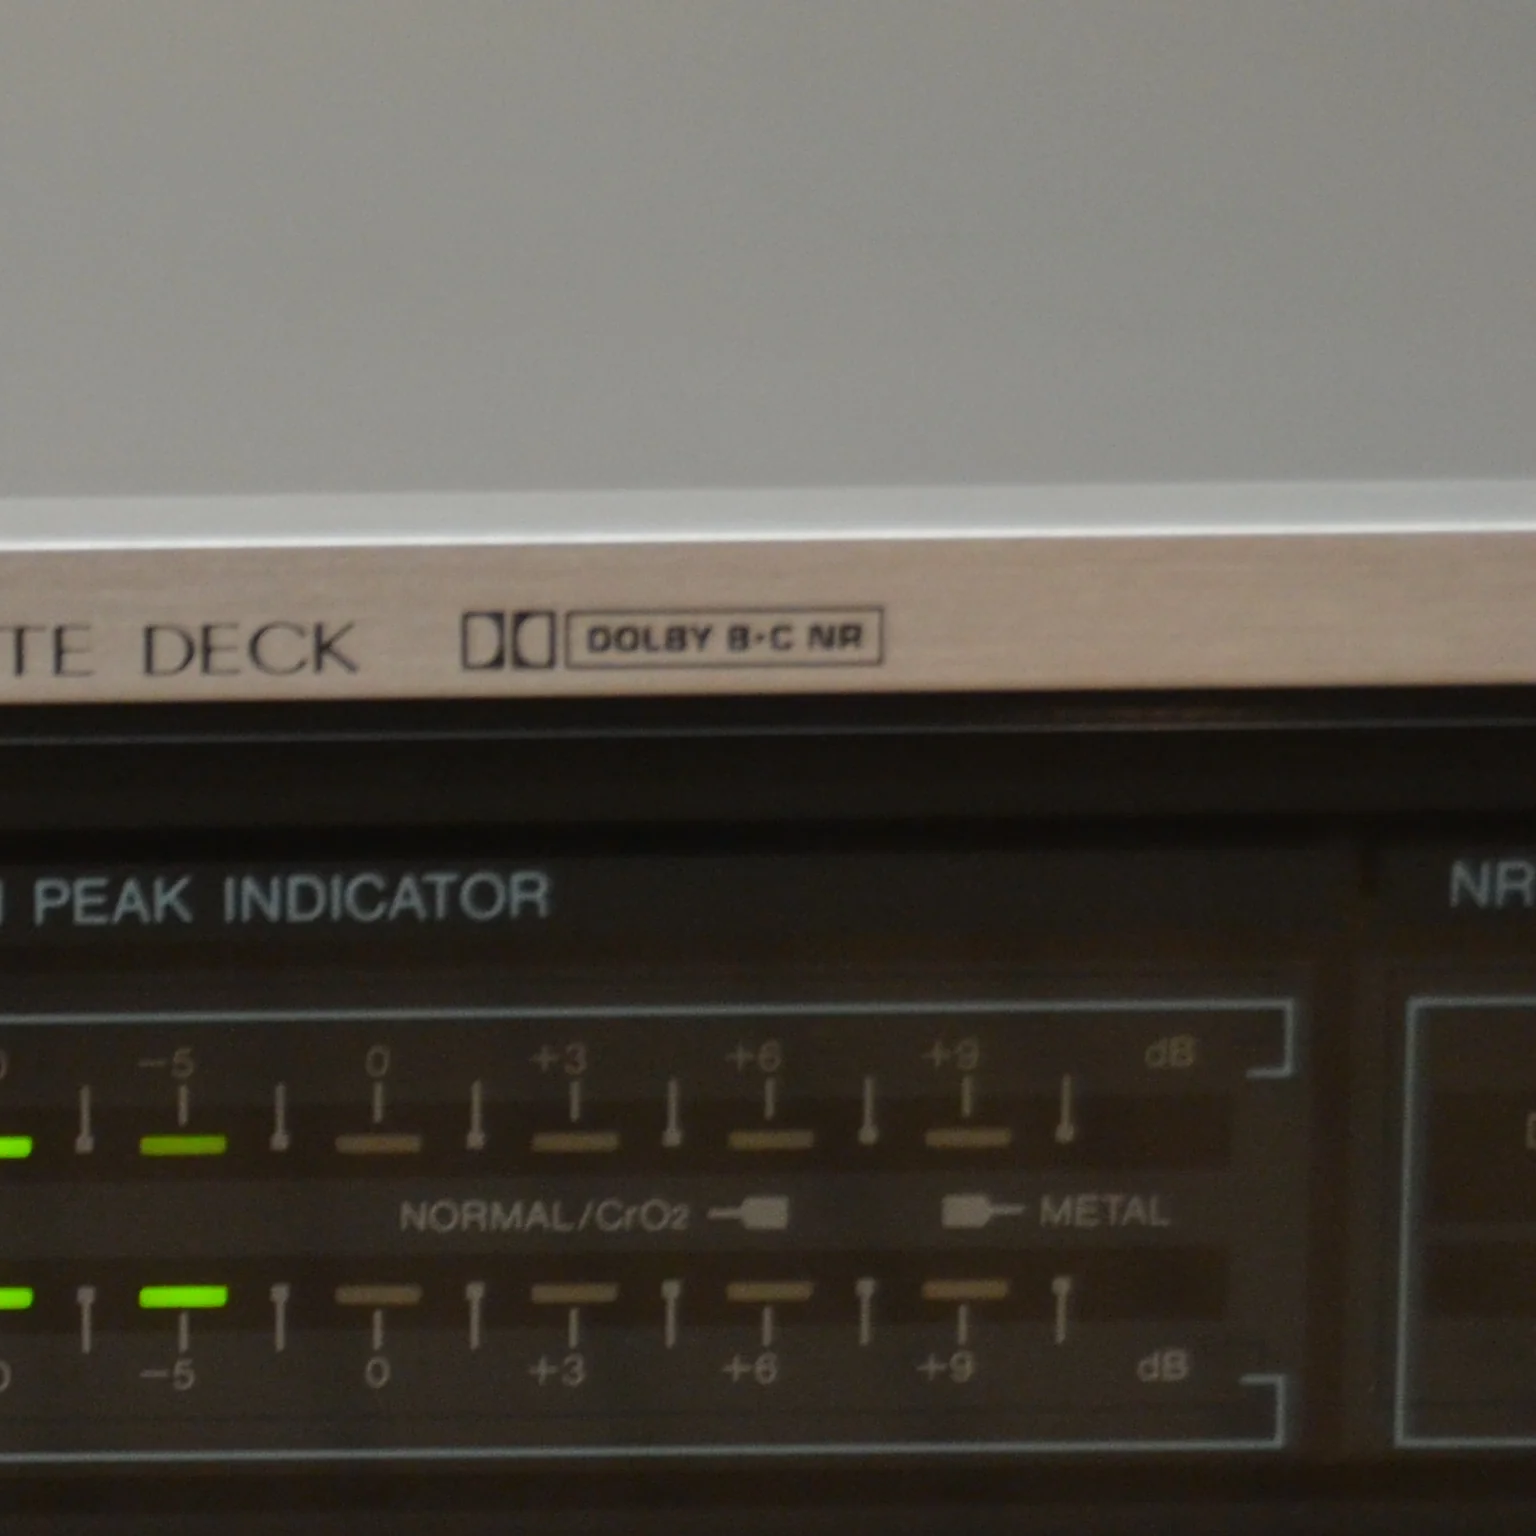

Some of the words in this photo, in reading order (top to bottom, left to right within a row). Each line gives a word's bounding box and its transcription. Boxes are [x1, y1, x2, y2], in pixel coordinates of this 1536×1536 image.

[142, 621, 359, 678] DECK
[586, 624, 711, 655] DOLBY
[807, 622, 864, 651] NR
[33, 875, 195, 926] PEAK
[225, 870, 552, 924] INDICATOR
[138, 1047, 195, 1079] -5
[365, 1045, 391, 1077] 0
[532, 1042, 589, 1075] +3
[727, 1040, 783, 1073] +6
[922, 1037, 979, 1071] +9
[1144, 1034, 1197, 1068] dB
[1040, 1194, 1171, 1228] METAL
[139, 1358, 196, 1391] -5
[365, 1356, 391, 1389] 0
[529, 1353, 587, 1387] +3
[722, 1352, 778, 1385] +6
[916, 1351, 976, 1383] +9
[1136, 1348, 1190, 1382] dB
